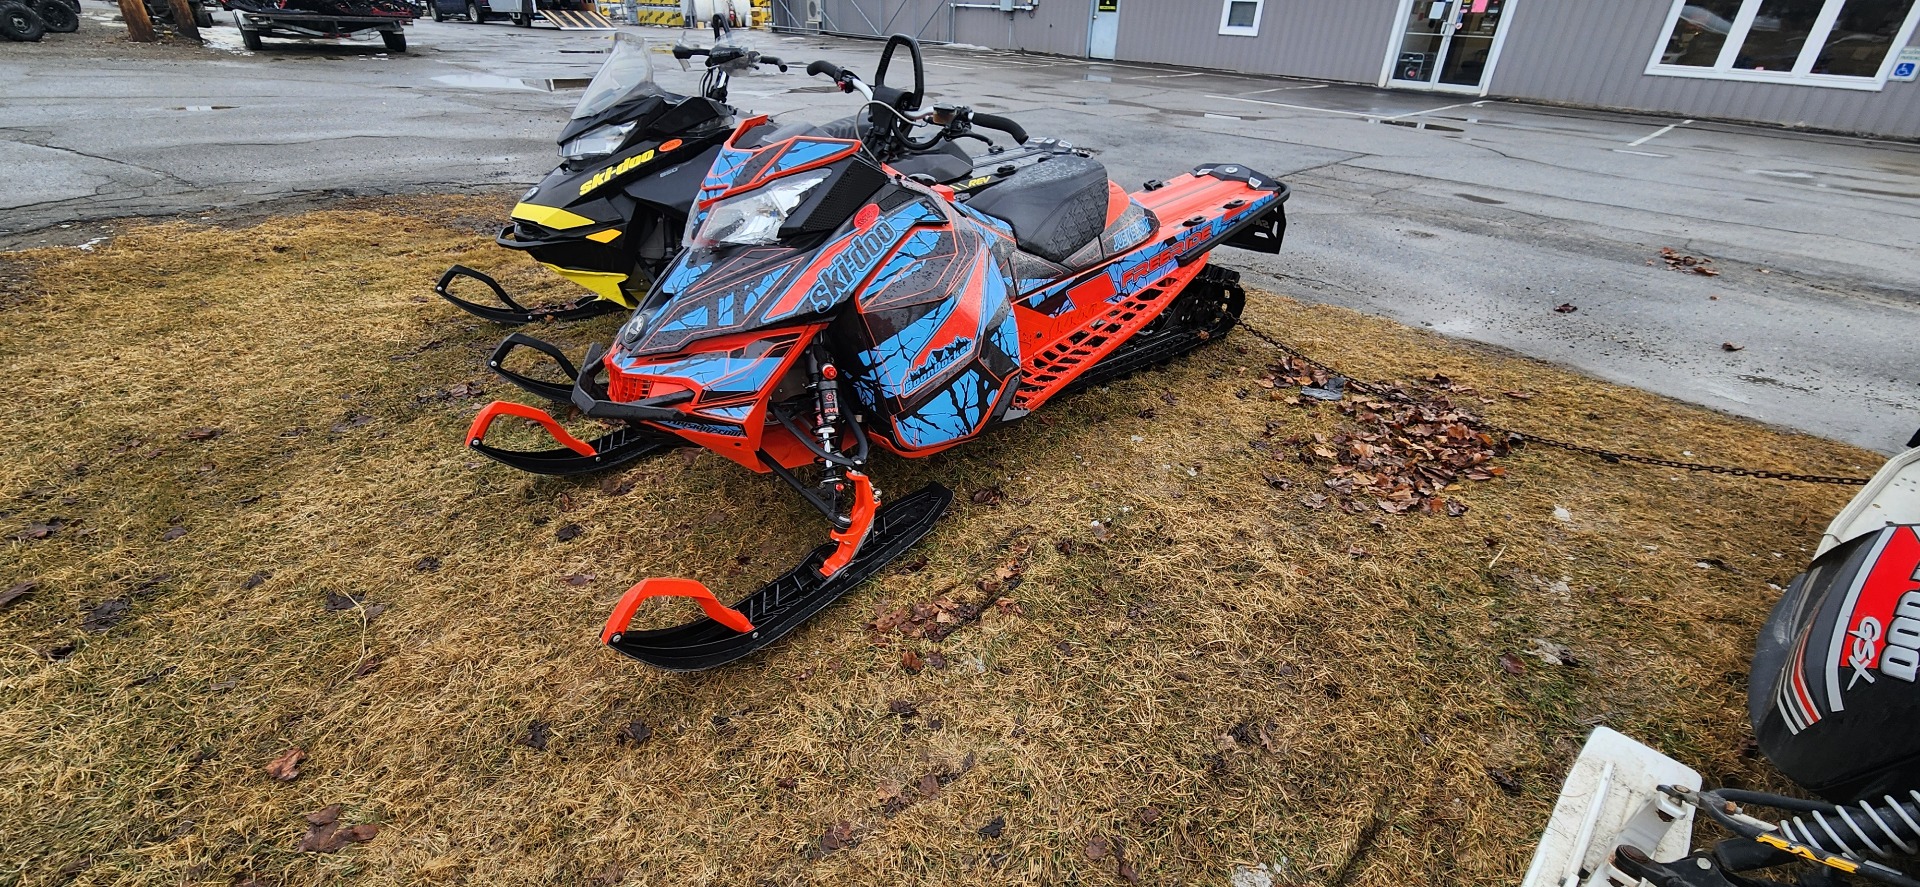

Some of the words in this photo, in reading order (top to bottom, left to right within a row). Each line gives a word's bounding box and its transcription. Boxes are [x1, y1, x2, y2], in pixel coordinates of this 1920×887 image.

[579, 149, 655, 196] ski-doo
[968, 176, 991, 188] REV
[809, 219, 897, 313] ski-doo
[1121, 224, 1213, 288] FREERIDE
[1847, 615, 1882, 692] GSX
